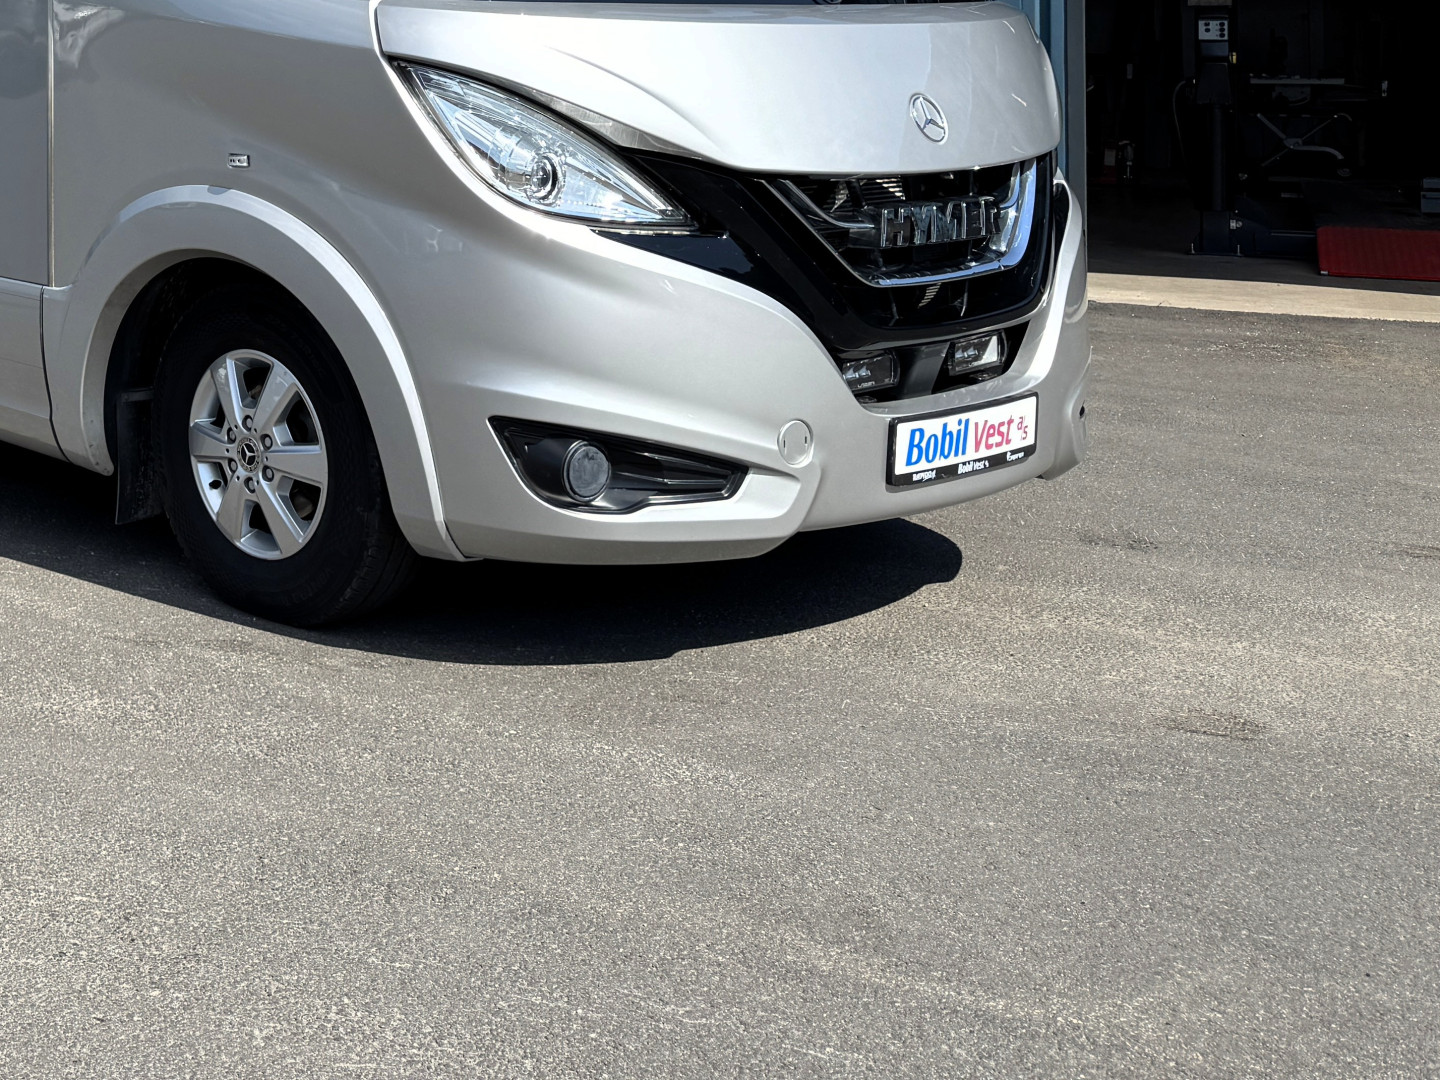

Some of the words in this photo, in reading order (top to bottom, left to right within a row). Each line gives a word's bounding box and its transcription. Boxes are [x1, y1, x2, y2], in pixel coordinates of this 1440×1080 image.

[880, 196, 1001, 248] HYMER
[905, 418, 970, 467] Bobil
[974, 415, 1015, 453] Vest
